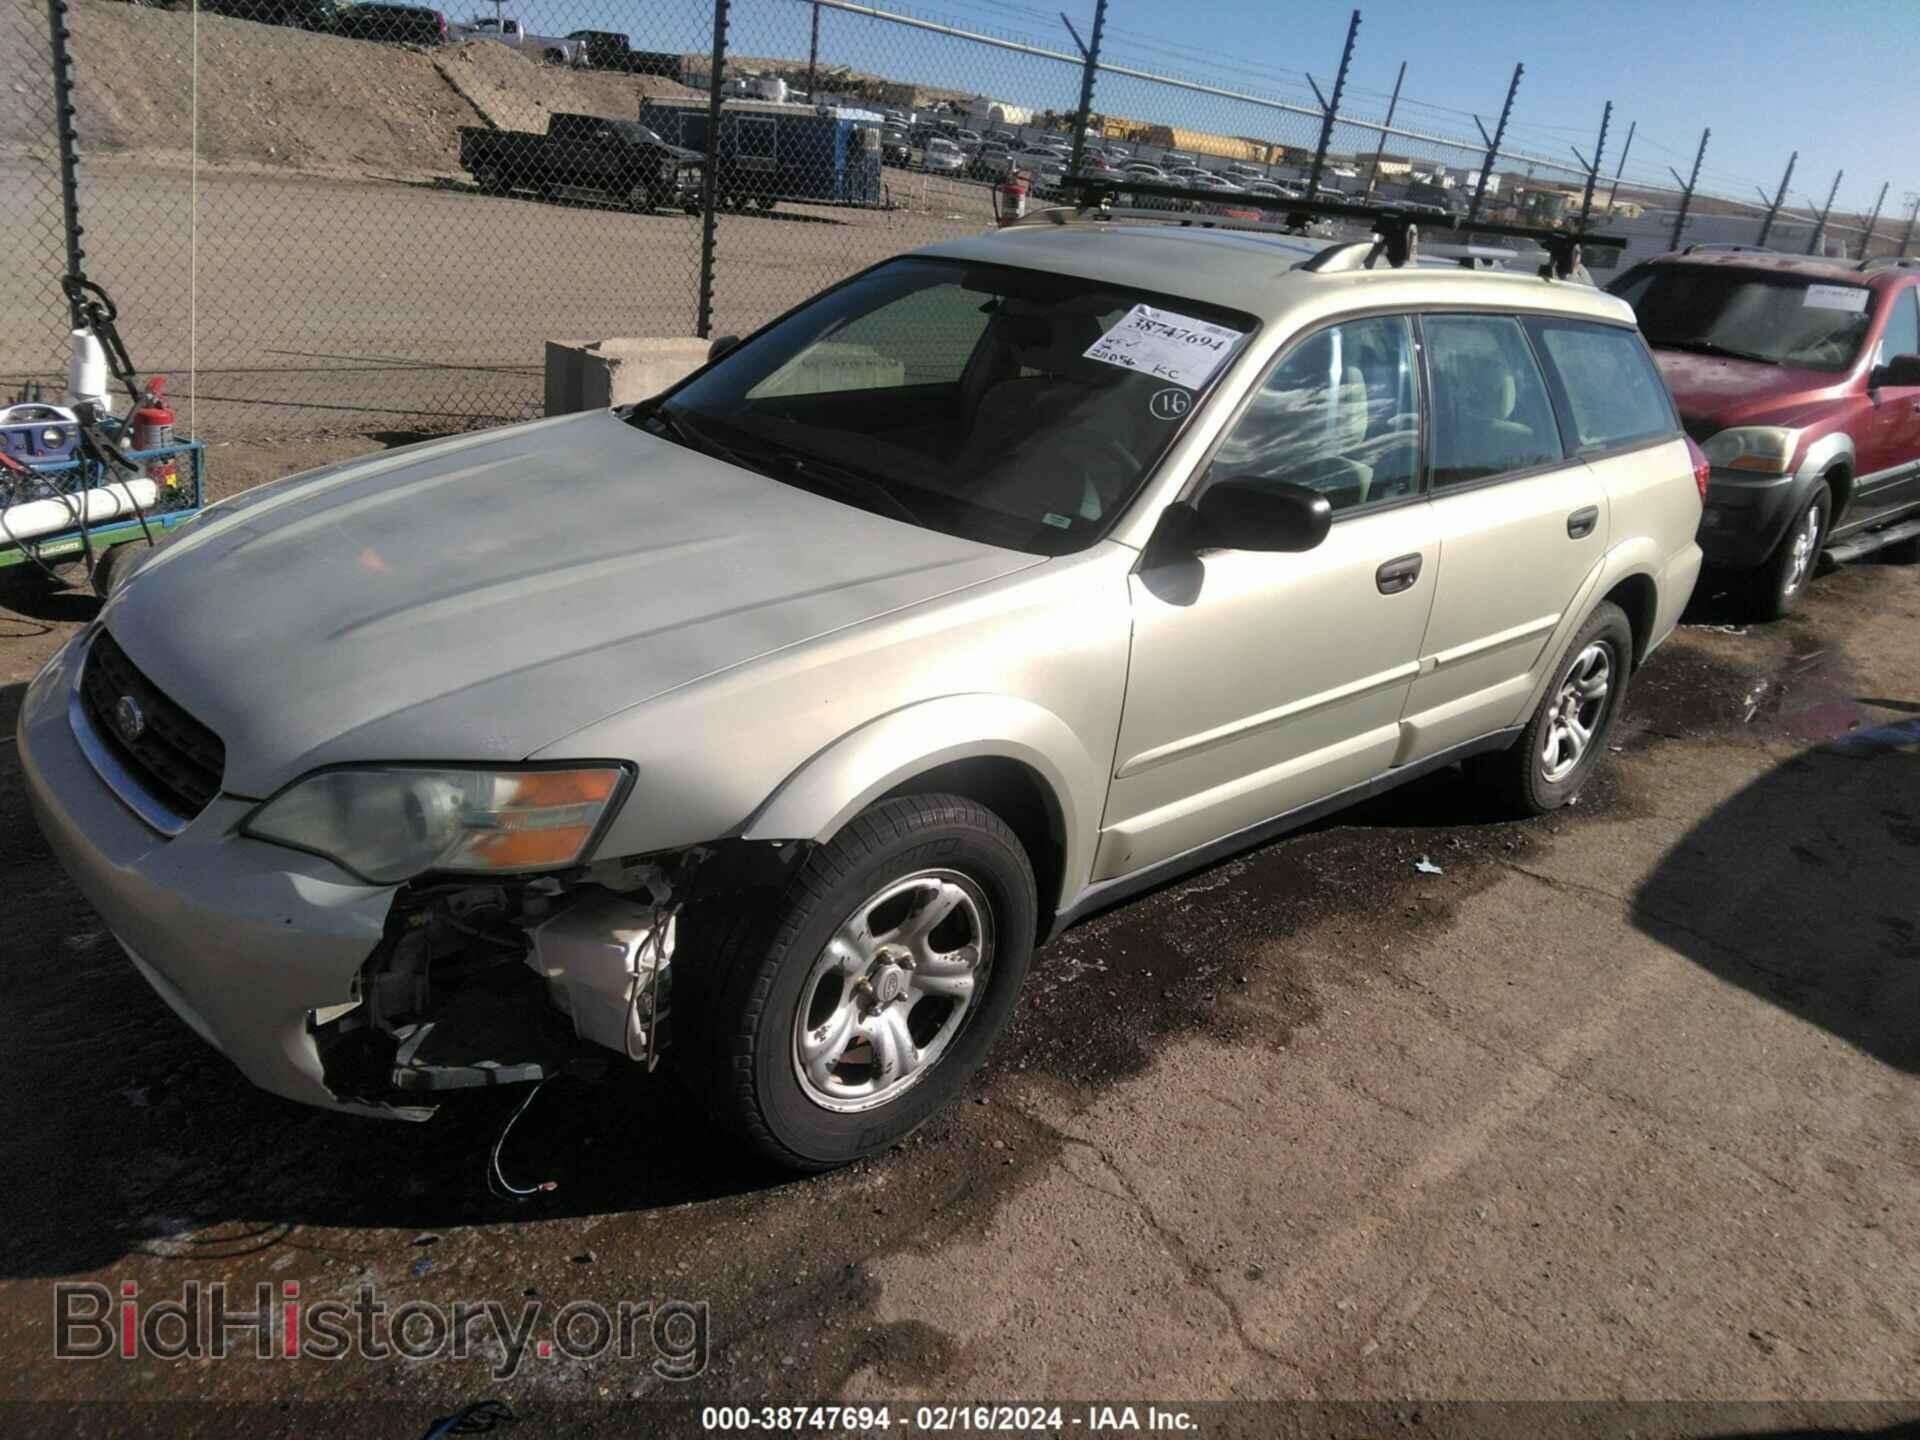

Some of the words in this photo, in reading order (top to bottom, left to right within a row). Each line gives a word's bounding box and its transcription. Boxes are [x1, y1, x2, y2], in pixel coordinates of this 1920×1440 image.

[1128, 319, 1225, 351] 38747694
[1152, 364, 1180, 380] KC
[1163, 393, 1187, 414] 16
